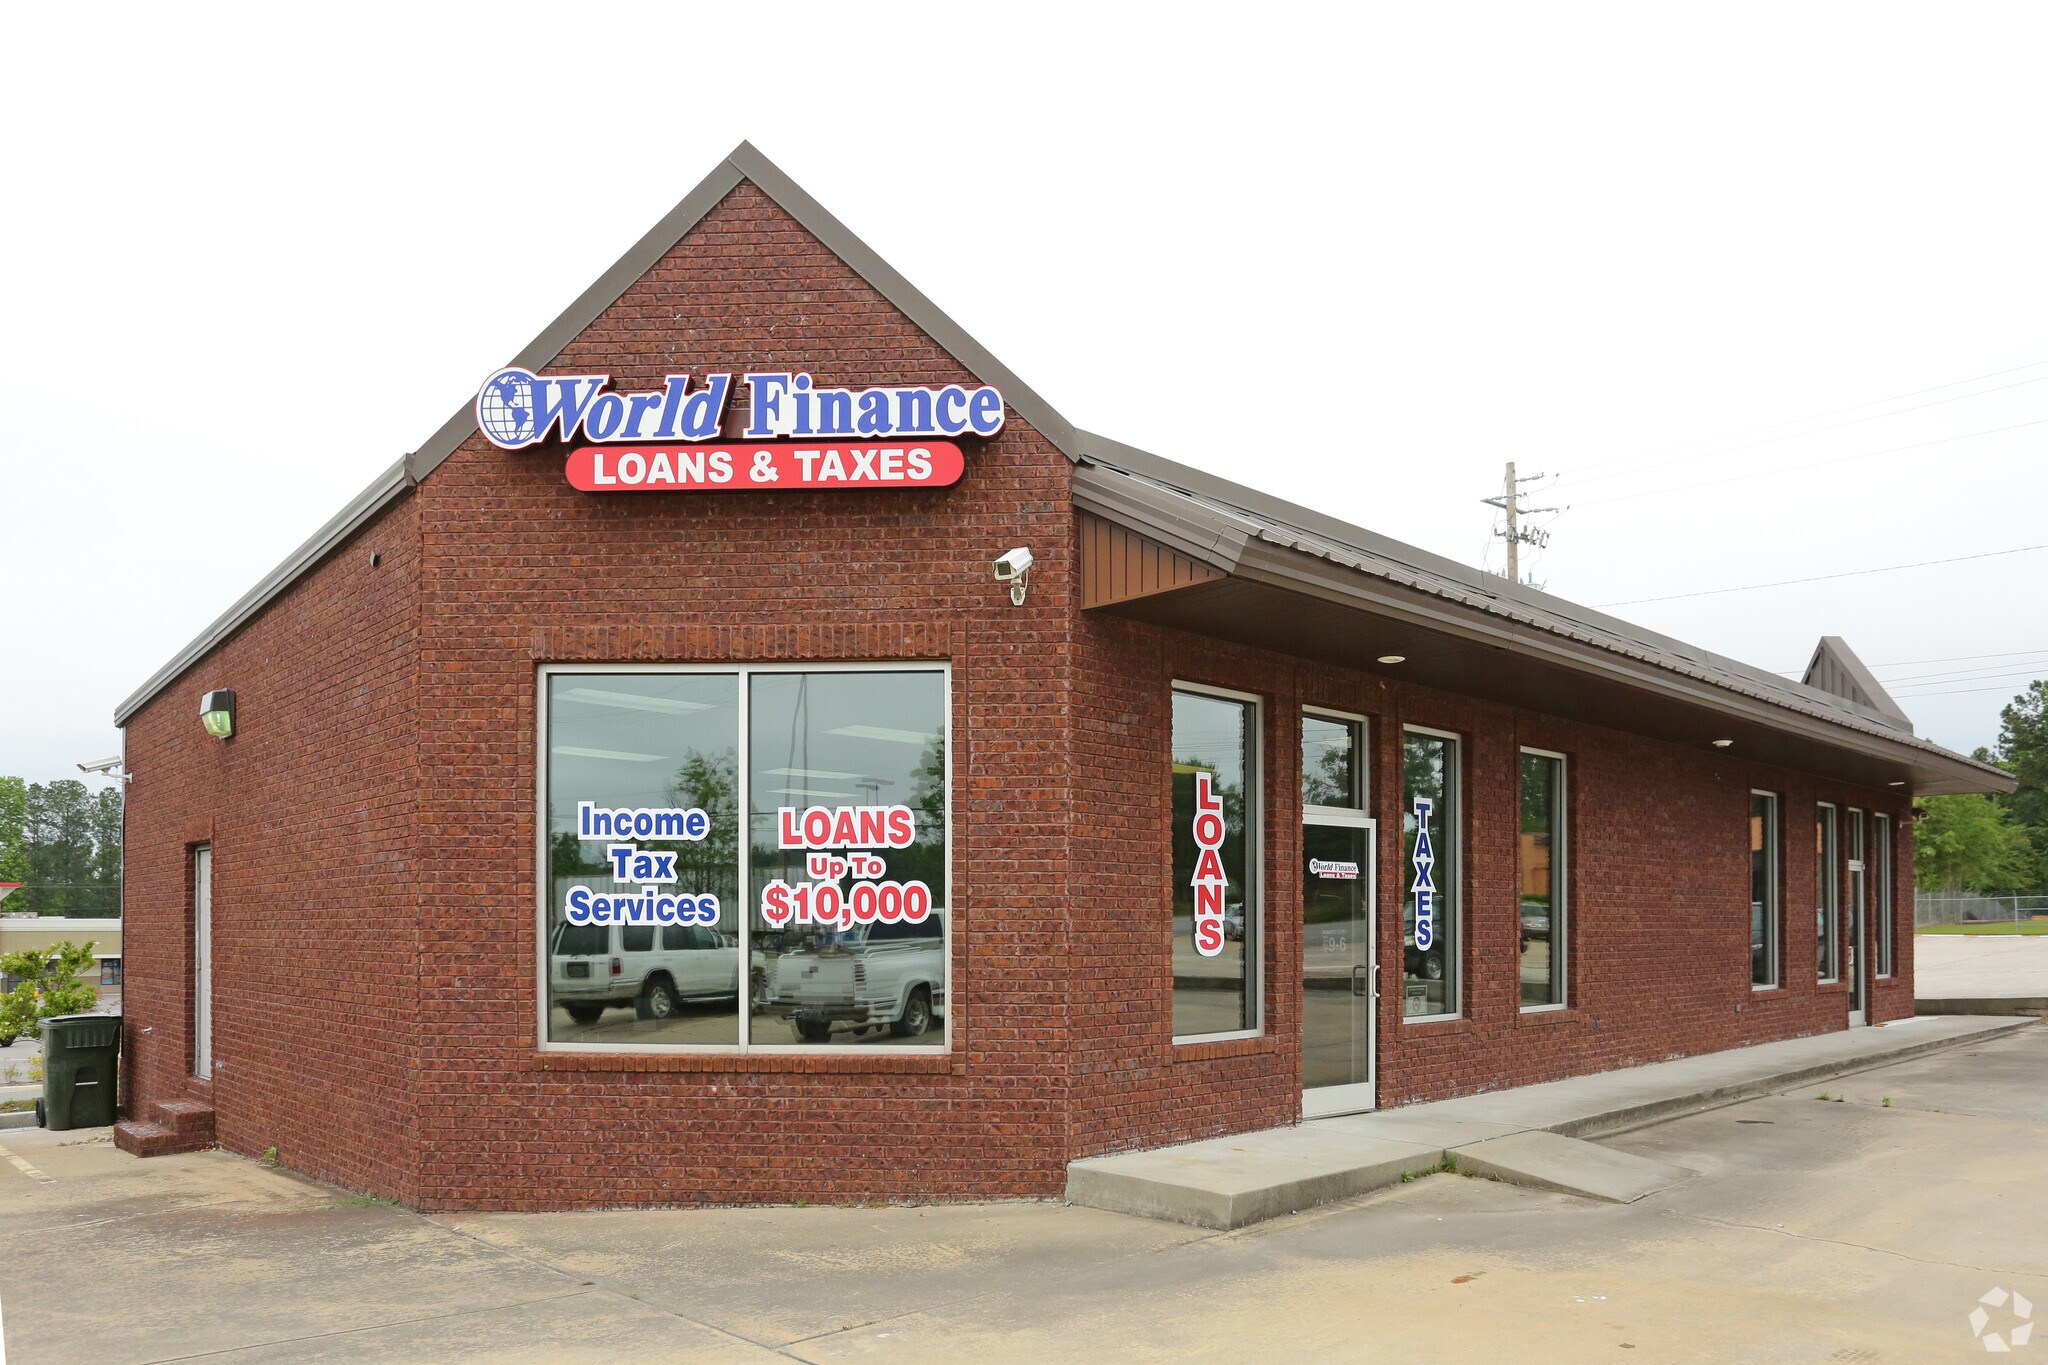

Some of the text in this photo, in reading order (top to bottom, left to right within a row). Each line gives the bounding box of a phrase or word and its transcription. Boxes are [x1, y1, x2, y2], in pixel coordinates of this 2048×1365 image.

[530, 374, 1001, 440] World Finance
[593, 448, 933, 485] LOANS & TAXES
[582, 806, 705, 836] Income
[782, 810, 912, 845] LOANS
[611, 848, 673, 879] Tax
[810, 857, 882, 880] Up To
[1196, 778, 1223, 951] LOANS
[1316, 862, 1357, 872] World Finance
[1415, 803, 1432, 946] TAXES
[569, 890, 716, 922] Services
[766, 884, 928, 927] $10,000
